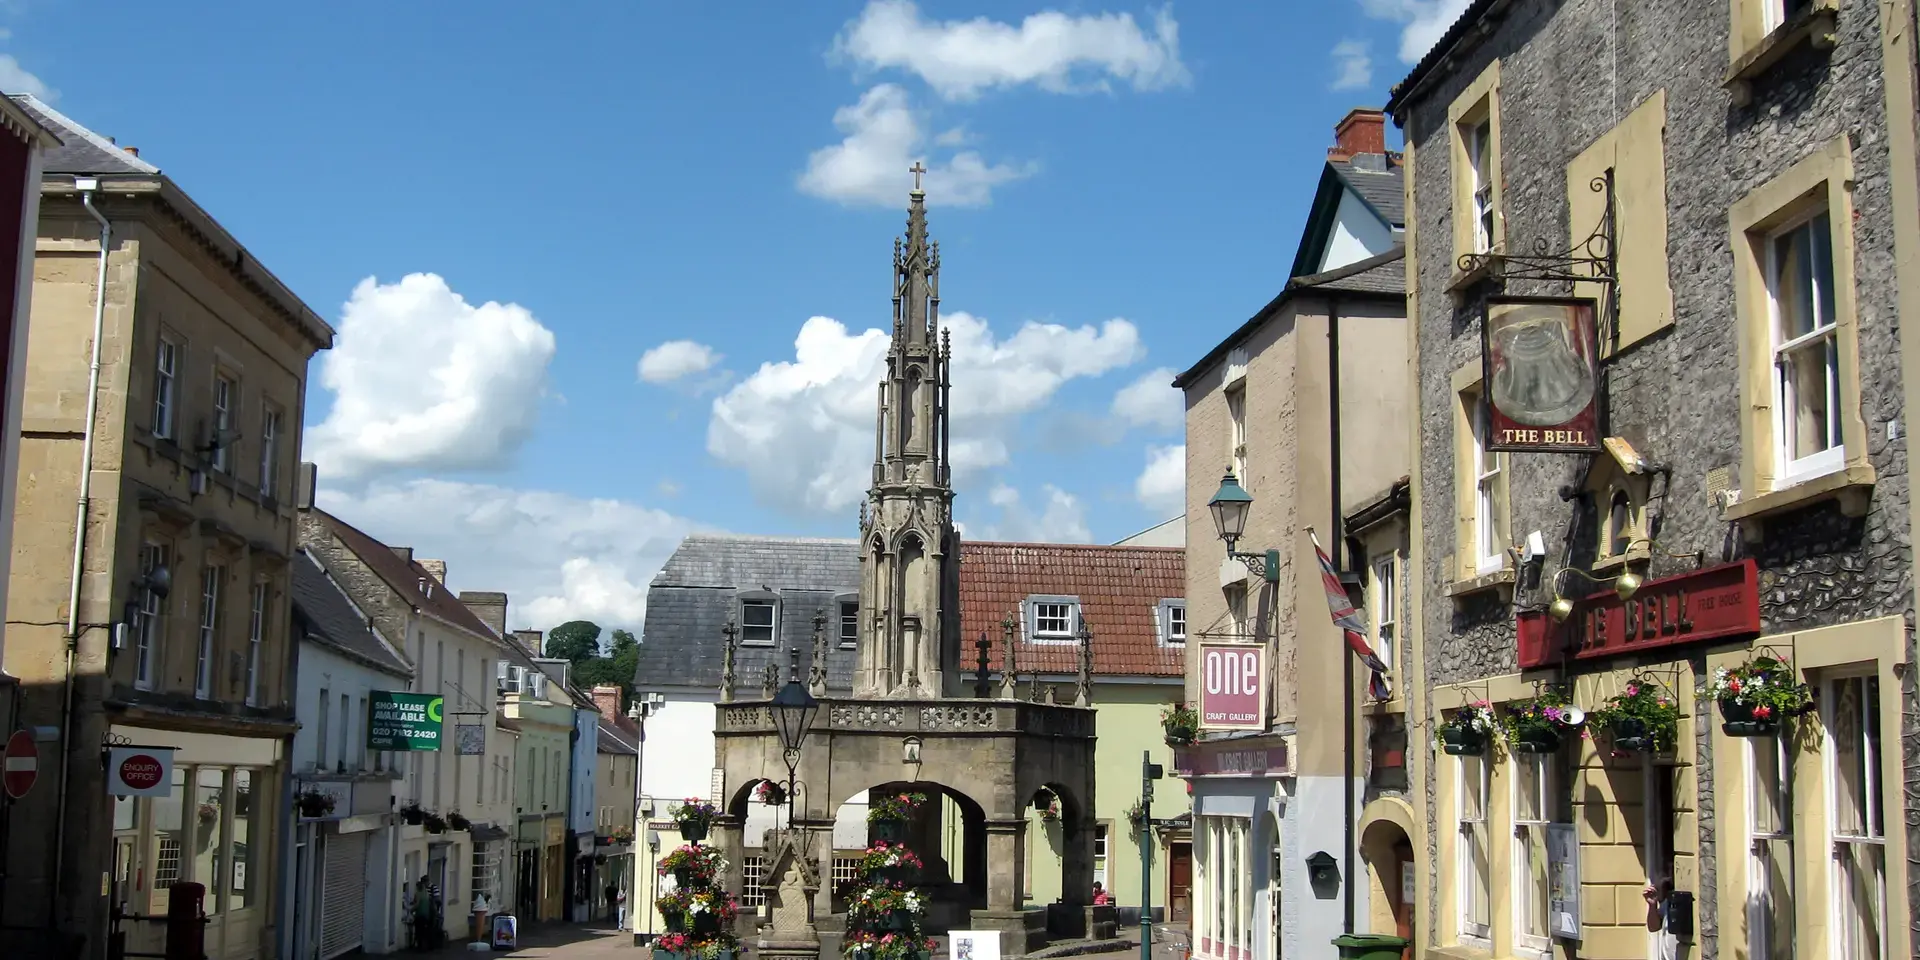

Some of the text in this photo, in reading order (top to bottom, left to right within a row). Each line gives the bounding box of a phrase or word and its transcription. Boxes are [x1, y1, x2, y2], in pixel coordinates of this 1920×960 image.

[1502, 429, 1588, 444] THE BELL
[1698, 591, 1742, 612] FREE HOUSE
[1567, 588, 1694, 649] HE BELL
[1206, 651, 1257, 695] one
[375, 702, 425, 712] SHOP LEASE
[375, 711, 425, 722] AVAILABLE
[1206, 712, 1257, 721] CRAFT GALLERY
[373, 727, 391, 736] 020
[414, 730, 437, 739] 2420
[124, 763, 158, 771] ENQUIRY
[127, 772, 155, 780] OFFICE
